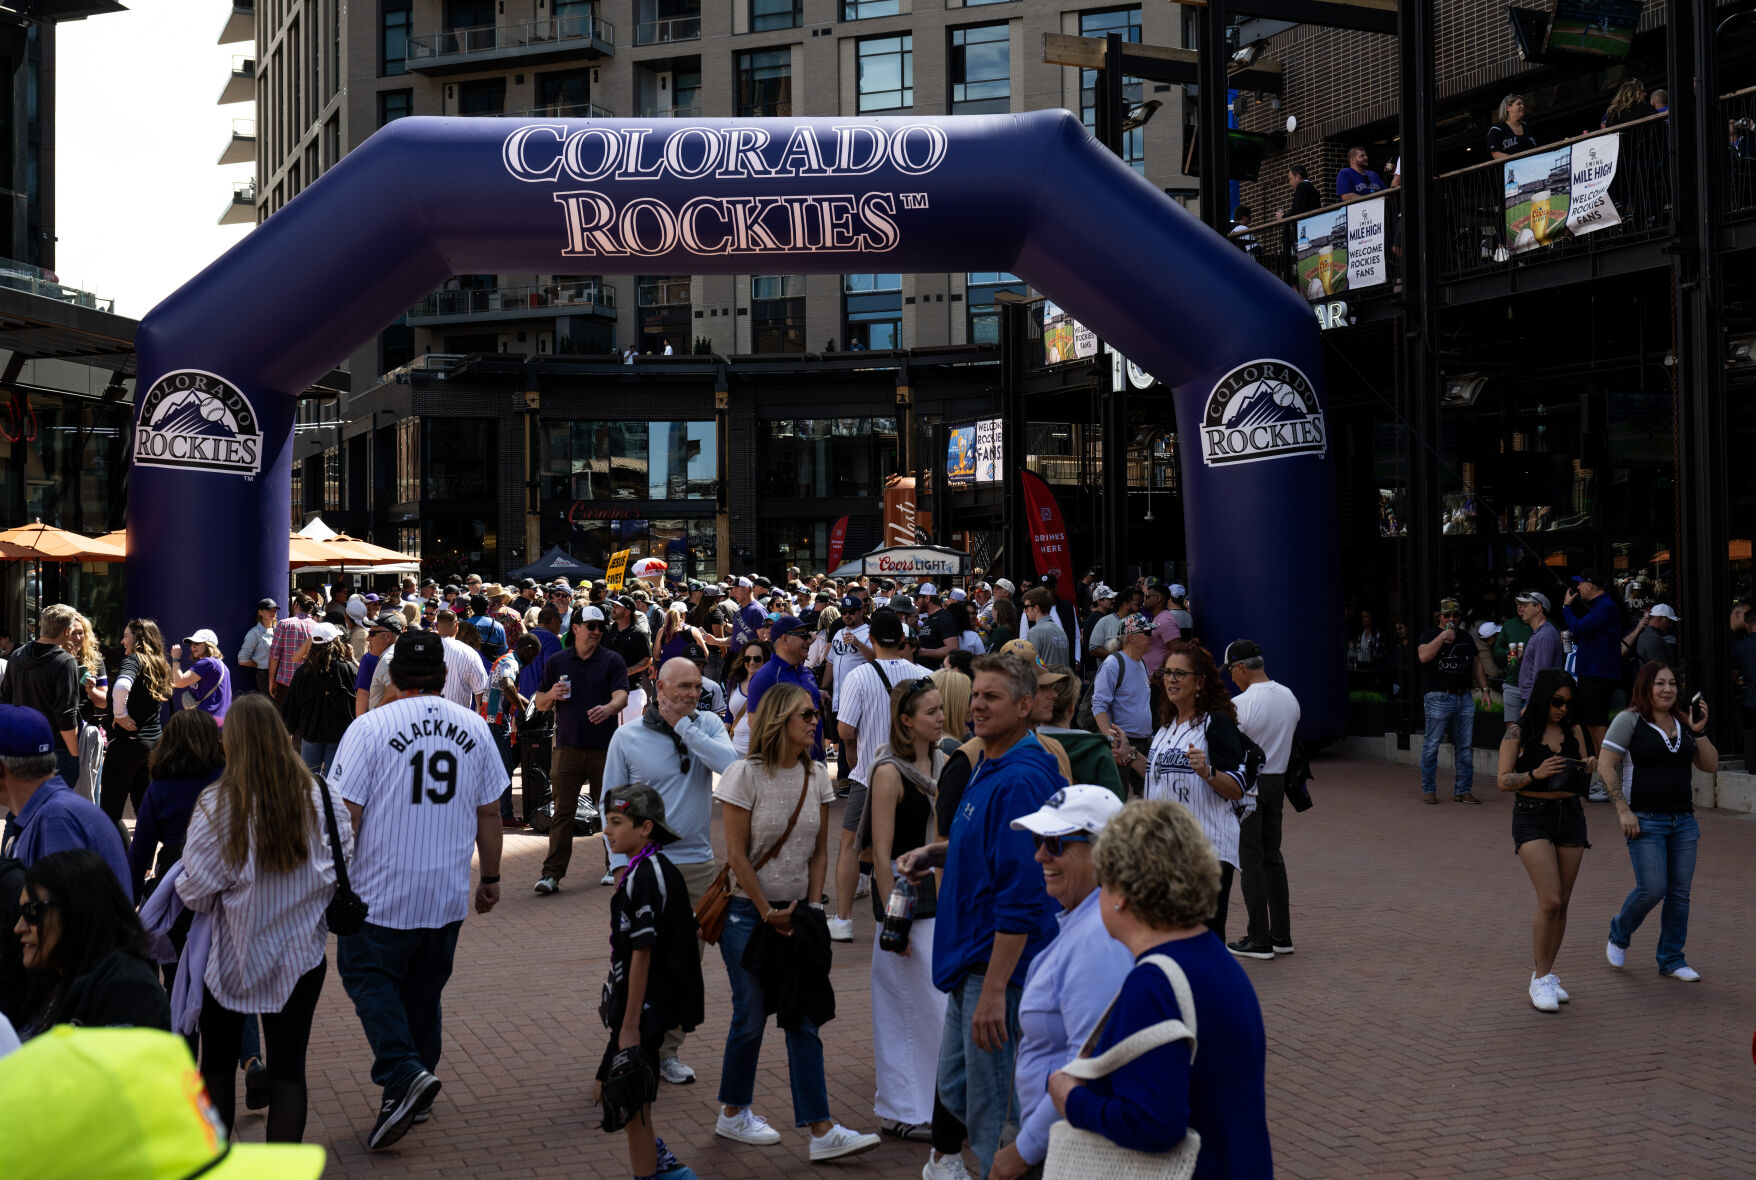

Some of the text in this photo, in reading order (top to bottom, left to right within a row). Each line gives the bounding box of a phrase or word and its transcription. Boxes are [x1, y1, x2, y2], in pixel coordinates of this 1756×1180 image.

[502, 124, 948, 182] COLORADO
[1573, 161, 1612, 185] MILE HIGH
[1572, 196, 1605, 216] ROCKIES
[553, 190, 900, 256] ROCKIES
[1576, 210, 1602, 225] FANS
[1349, 222, 1381, 241] MILE HIGH
[1349, 243, 1382, 258] WELCOME
[1350, 255, 1380, 269] ROCKIES
[1356, 267, 1374, 278] FANS
[1075, 332, 1094, 342] ROCKIES
[1080, 341, 1092, 349] FANS
[143, 375, 251, 426] COLORADO
[1210, 364, 1314, 418] COLORADO
[1205, 416, 1323, 456] ROCKIES
[136, 428, 257, 465] ROCKIES
[567, 501, 641, 524] Carmine's
[1035, 532, 1065, 542] DRINKS
[1040, 545, 1062, 553] HERE
[609, 555, 627, 569] JESUS
[879, 556, 946, 571] Coors LIGHT
[388, 719, 476, 754] BLACKMON
[410, 750, 457, 805] 19
